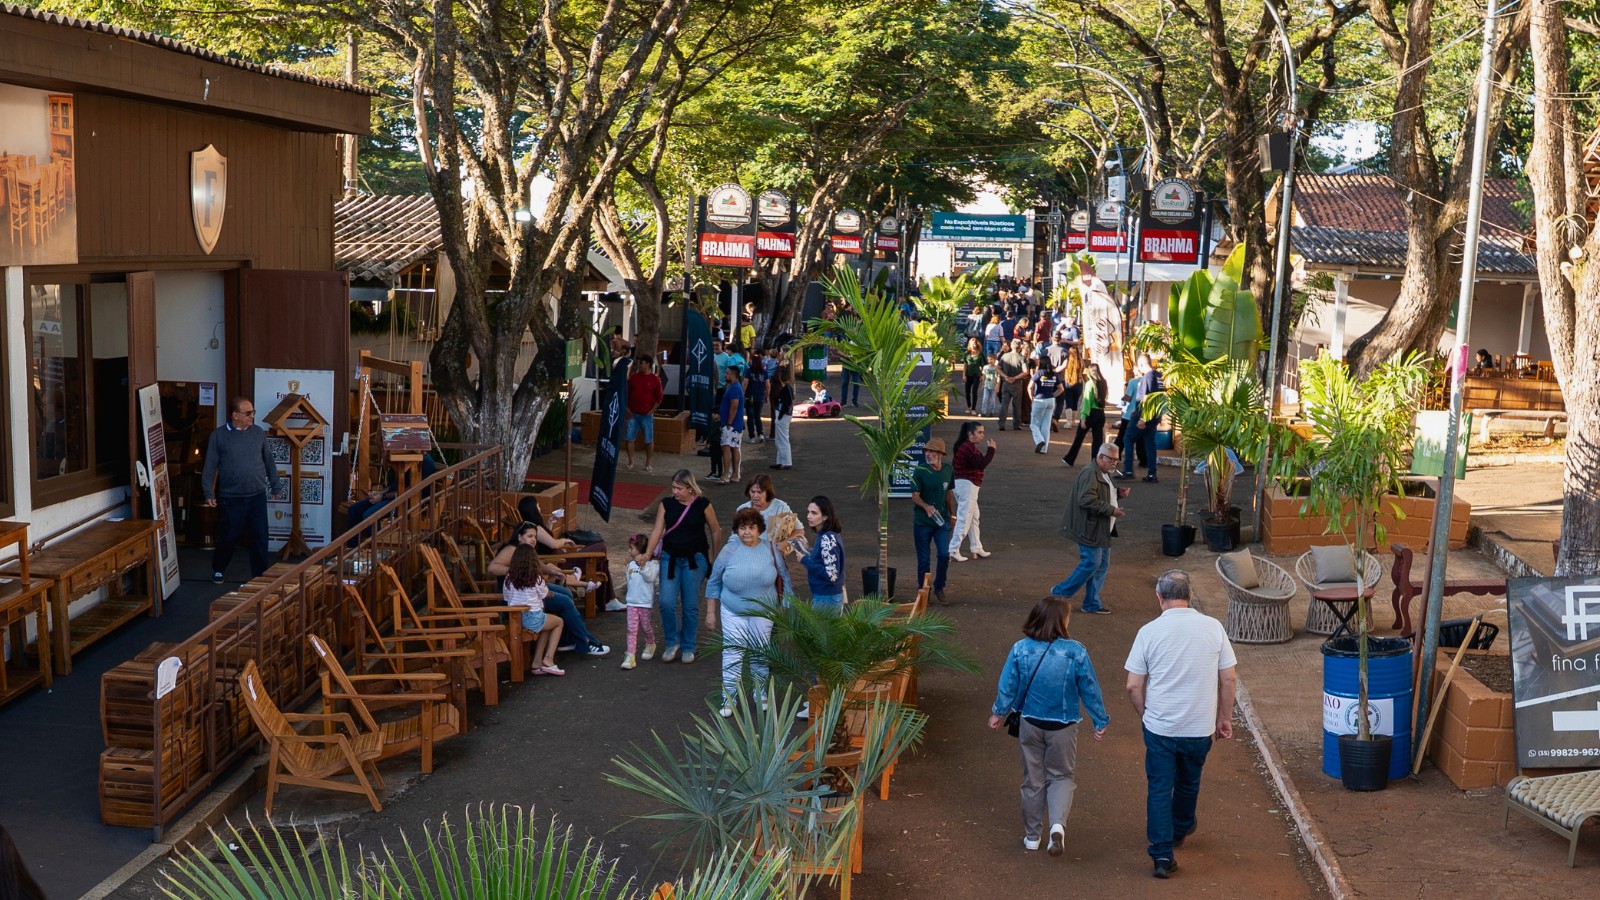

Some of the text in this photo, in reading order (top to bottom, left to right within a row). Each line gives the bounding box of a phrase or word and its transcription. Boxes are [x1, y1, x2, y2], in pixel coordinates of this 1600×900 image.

[204, 170, 218, 228] F
[702, 240, 750, 258] BRAHMA
[757, 238, 791, 251] RAHMA
[1144, 238, 1194, 253] BRAHMA
[1552, 654, 1586, 671] fina
[1324, 695, 1340, 710] IXO
[1550, 748, 1600, 757] 99829-962
